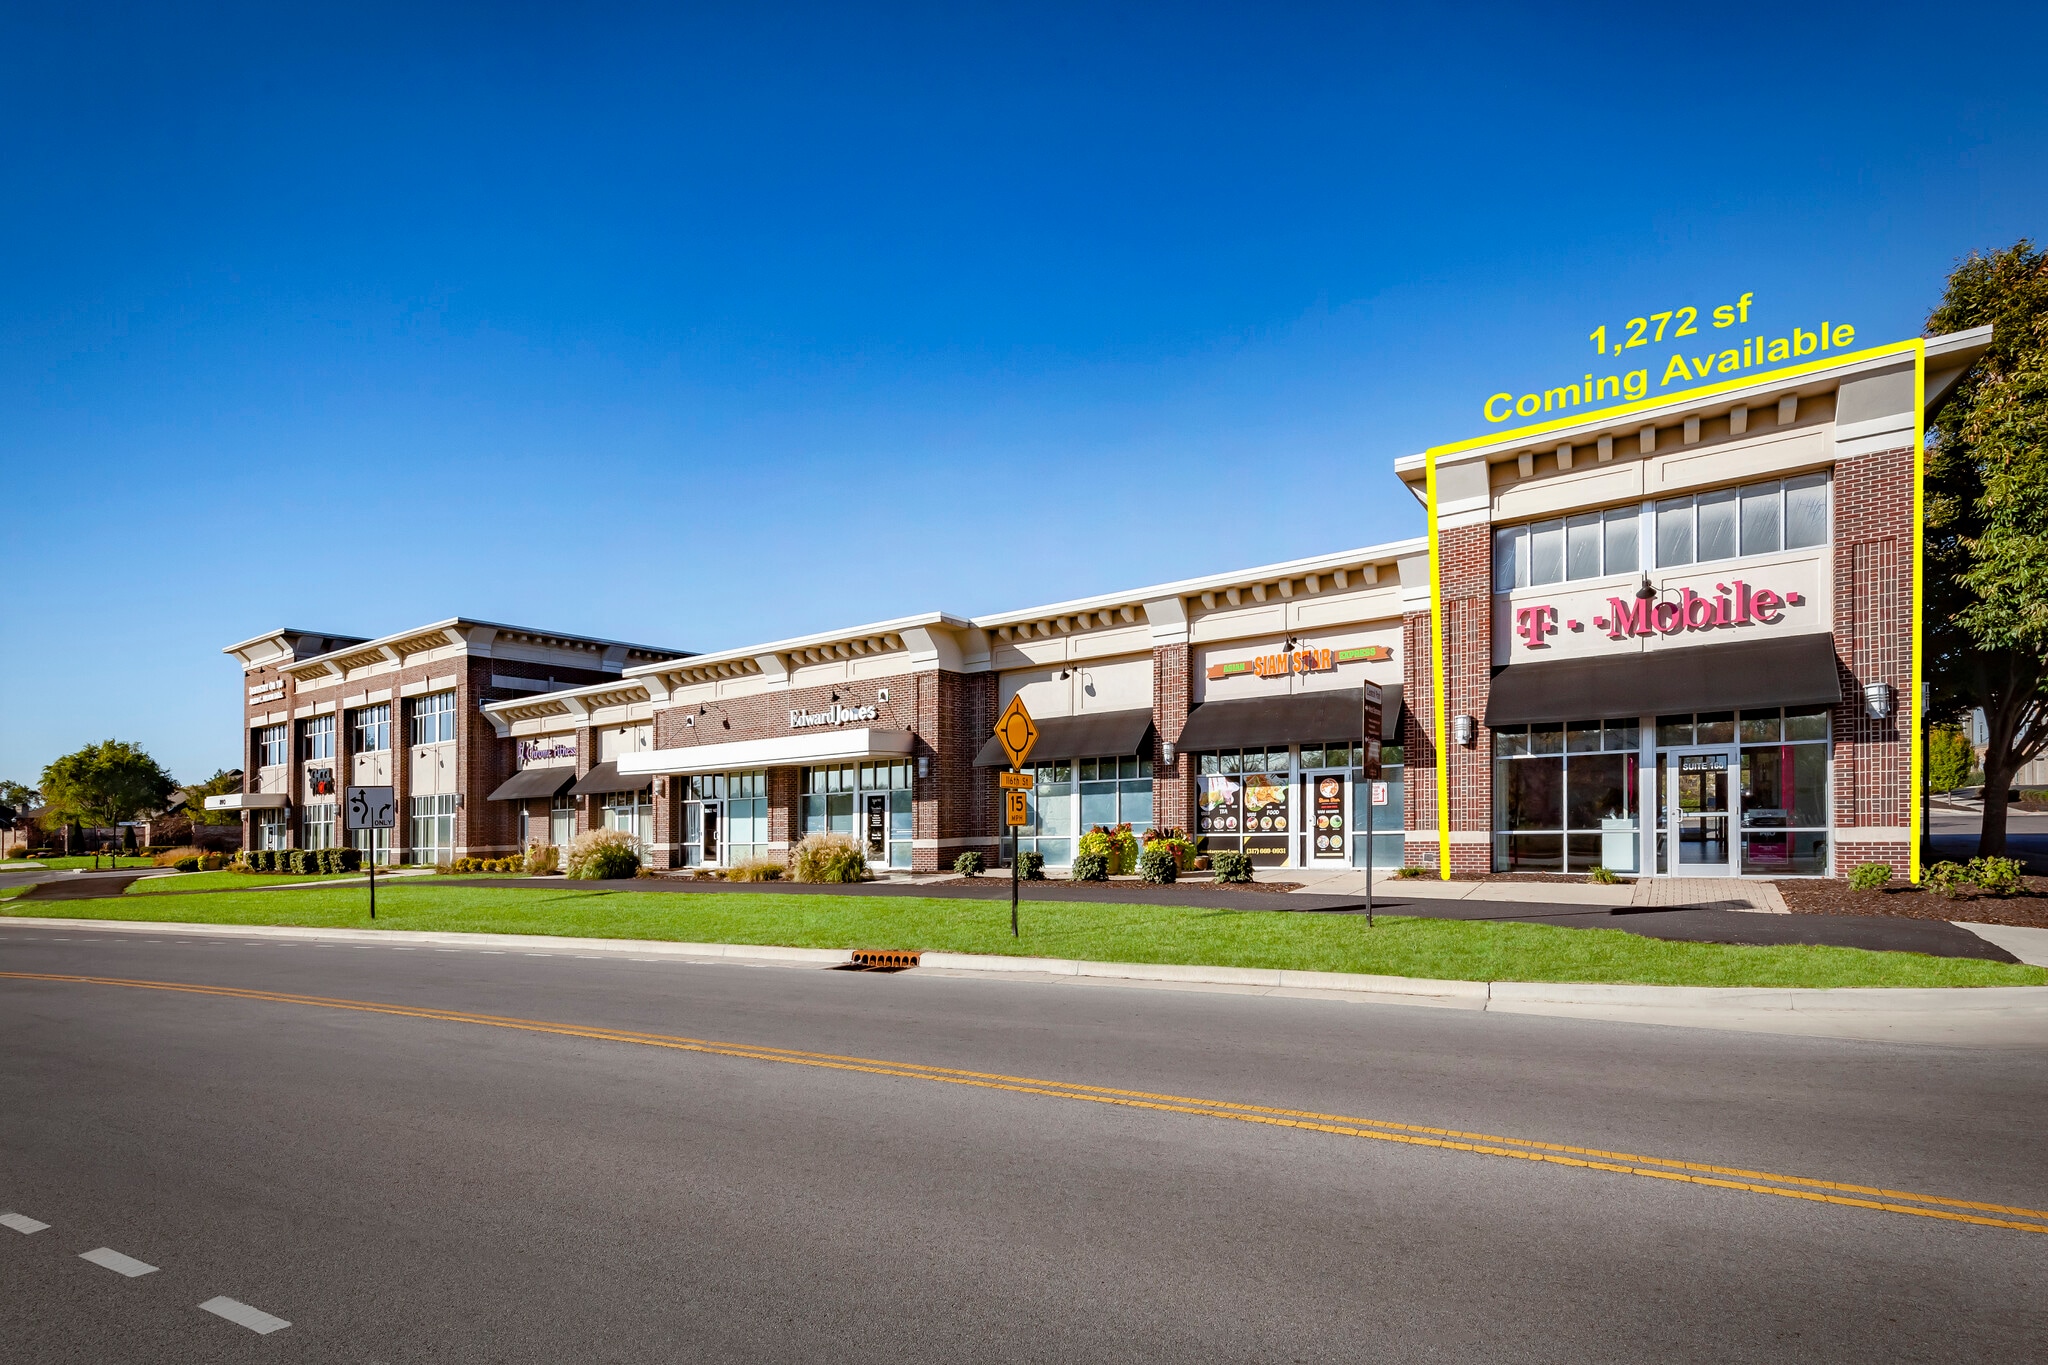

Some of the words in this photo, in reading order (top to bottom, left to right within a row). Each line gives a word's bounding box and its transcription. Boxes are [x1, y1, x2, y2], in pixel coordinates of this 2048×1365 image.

[1254, 653, 1288, 677] SIAM
[1293, 648, 1331, 673] STAR
[1682, 762, 1707, 770] SUITE
[1005, 775, 1019, 786] 116th
[1022, 777, 1029, 786] St
[1010, 795, 1024, 812] 15
